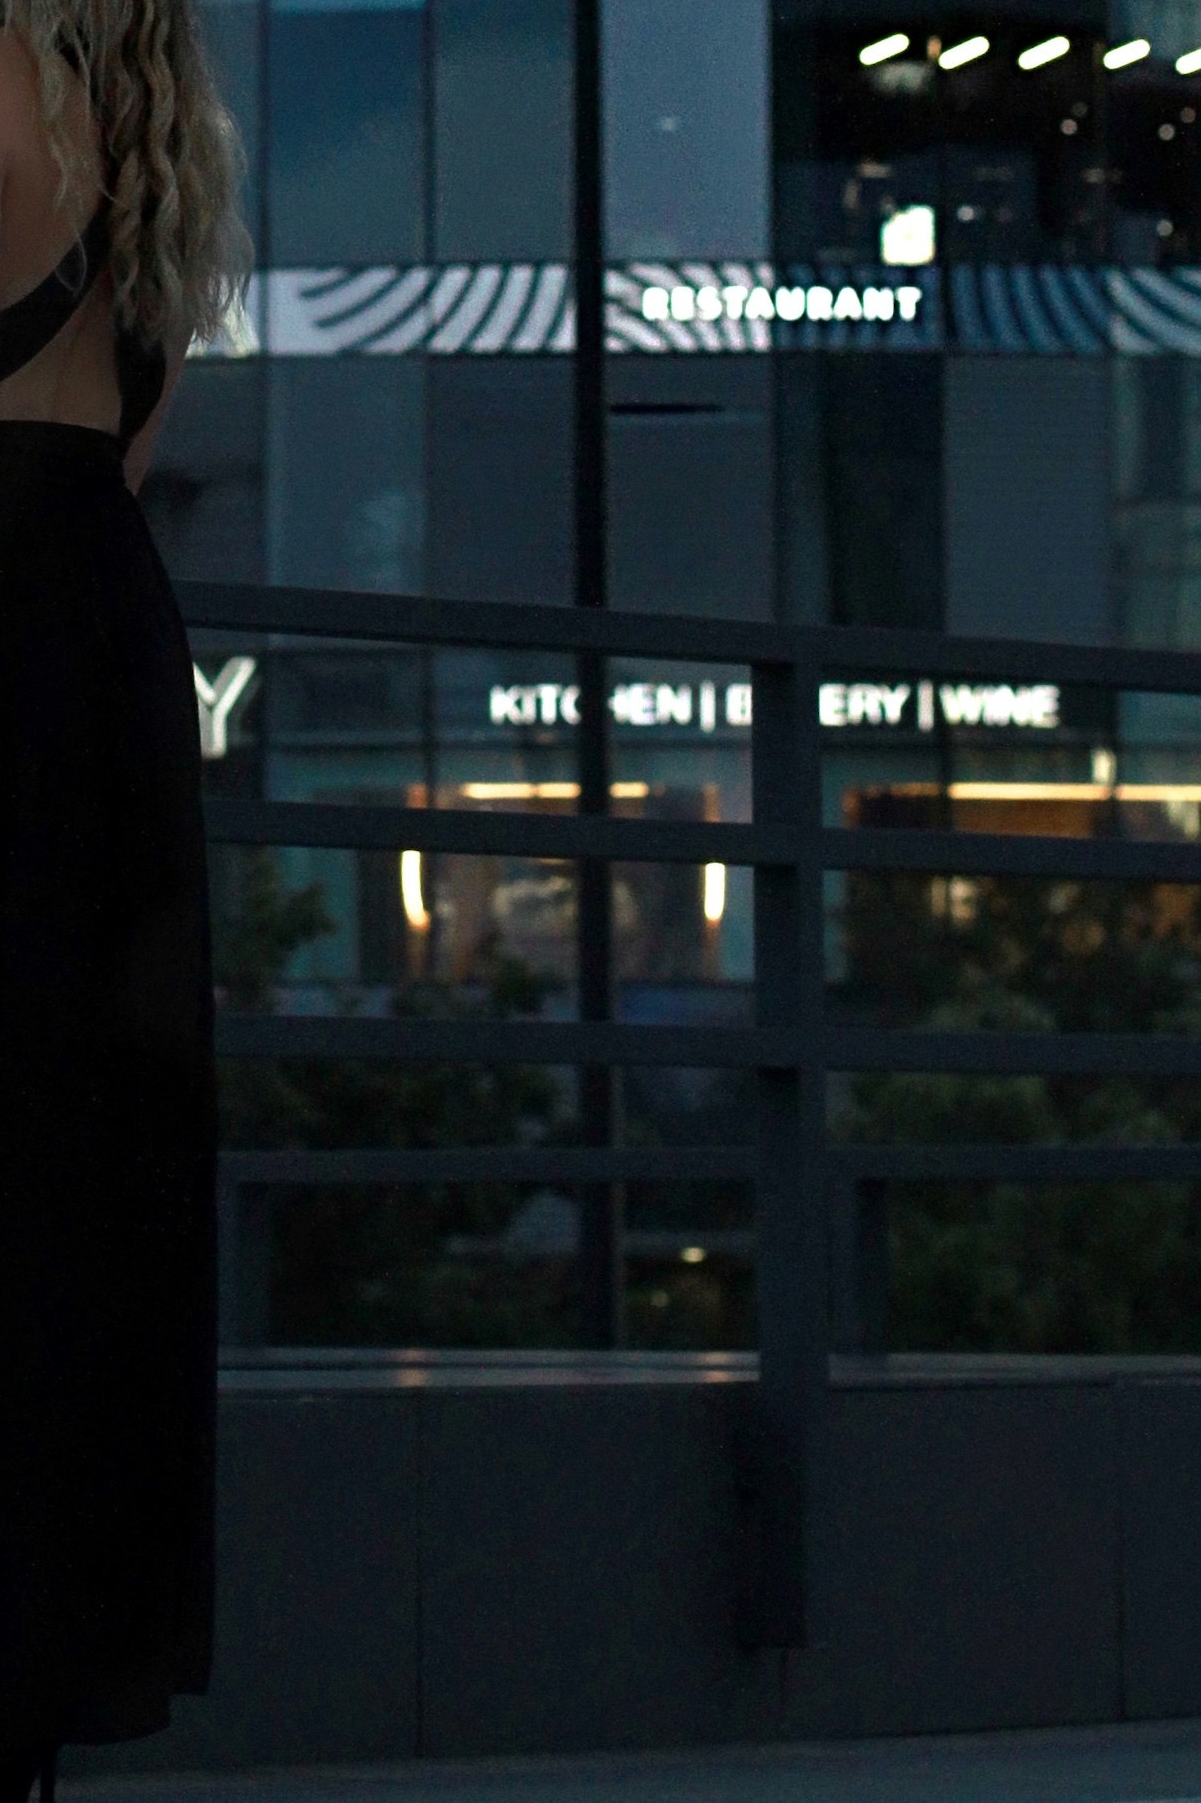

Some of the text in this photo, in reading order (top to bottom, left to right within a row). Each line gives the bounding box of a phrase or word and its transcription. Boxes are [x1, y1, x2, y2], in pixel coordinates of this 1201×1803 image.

[642, 285, 922, 322] RESTAURANT
[726, 683, 910, 726] BERY
[940, 684, 1060, 728] WINE
